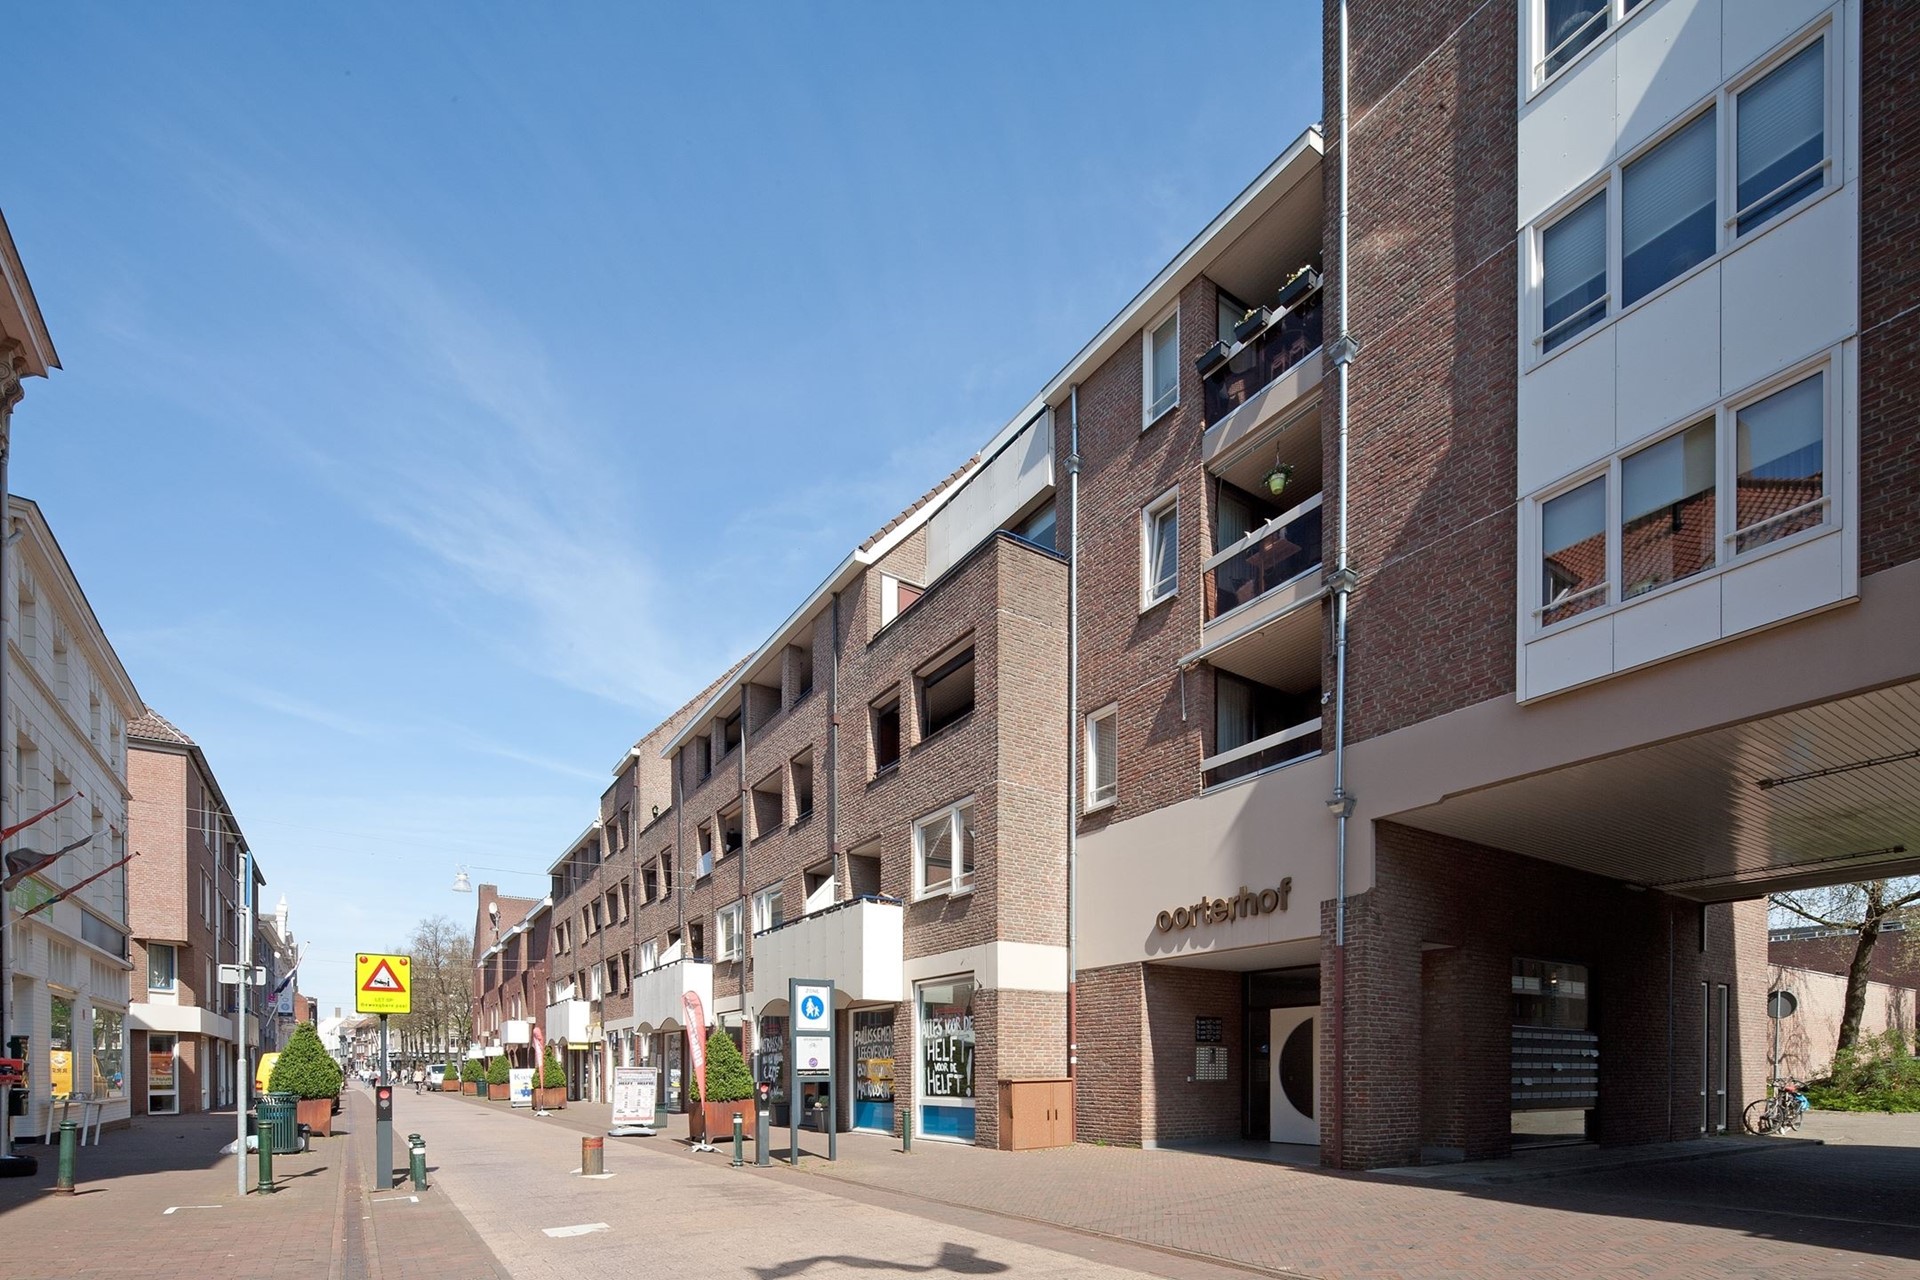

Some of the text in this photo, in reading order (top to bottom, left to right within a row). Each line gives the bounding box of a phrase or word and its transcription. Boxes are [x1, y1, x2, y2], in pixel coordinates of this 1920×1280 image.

[1156, 876, 1292, 933] oorterhof
[921, 1015, 974, 1039] ALLES VOOR DE
[927, 1035, 965, 1063] HELFT
[934, 1062, 958, 1073] VOOR DE
